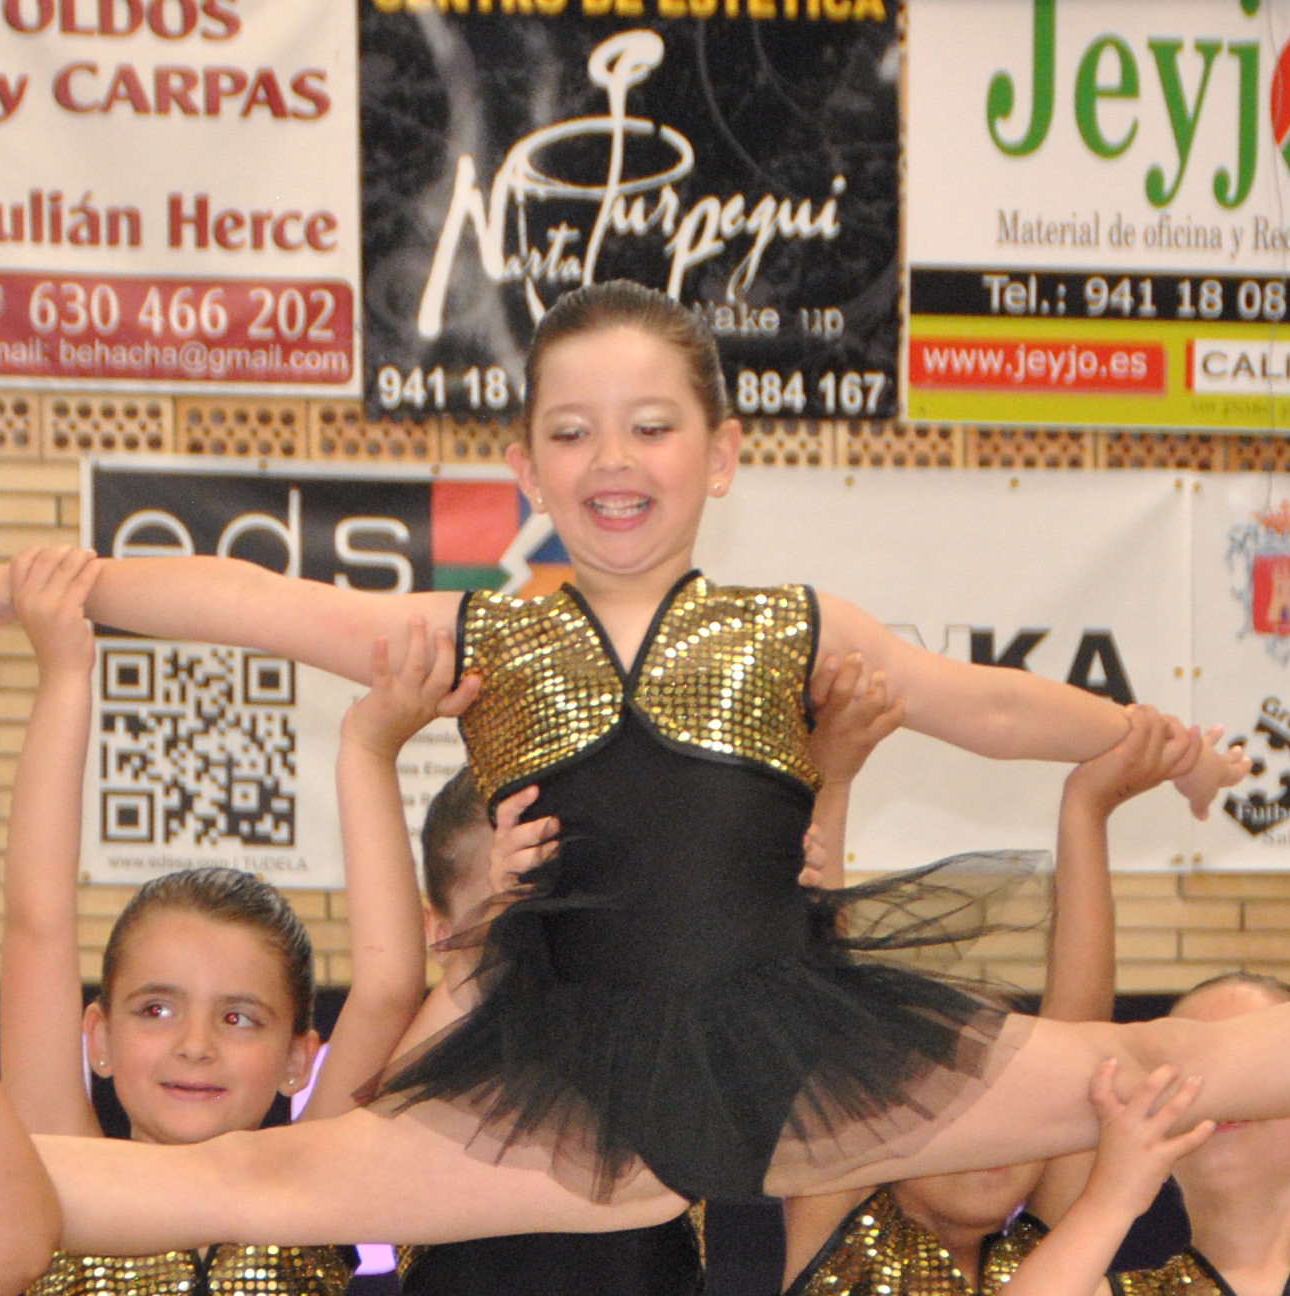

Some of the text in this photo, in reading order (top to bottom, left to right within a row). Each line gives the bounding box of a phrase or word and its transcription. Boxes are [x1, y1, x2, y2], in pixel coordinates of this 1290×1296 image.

[53, 62, 331, 119] CARPAS
[168, 194, 339, 250] Herce
[997, 210, 1100, 247] Material
[1110, 214, 1136, 247] de
[1143, 214, 1222, 249] oficina
[1231, 226, 1245, 260] y
[29, 282, 336, 340] 630 466 202
[691, 301, 845, 340] ake up
[982, 274, 1067, 315] Tel.:
[1084, 277, 1156, 317] 941
[1178, 279, 1223, 318] 18
[1237, 281, 1287, 320] 08
[58, 340, 350, 378] behacha@gmail.com
[922, 345, 1148, 380] www.jeyjo.es
[377, 365, 886, 415] 941 18 884 167
